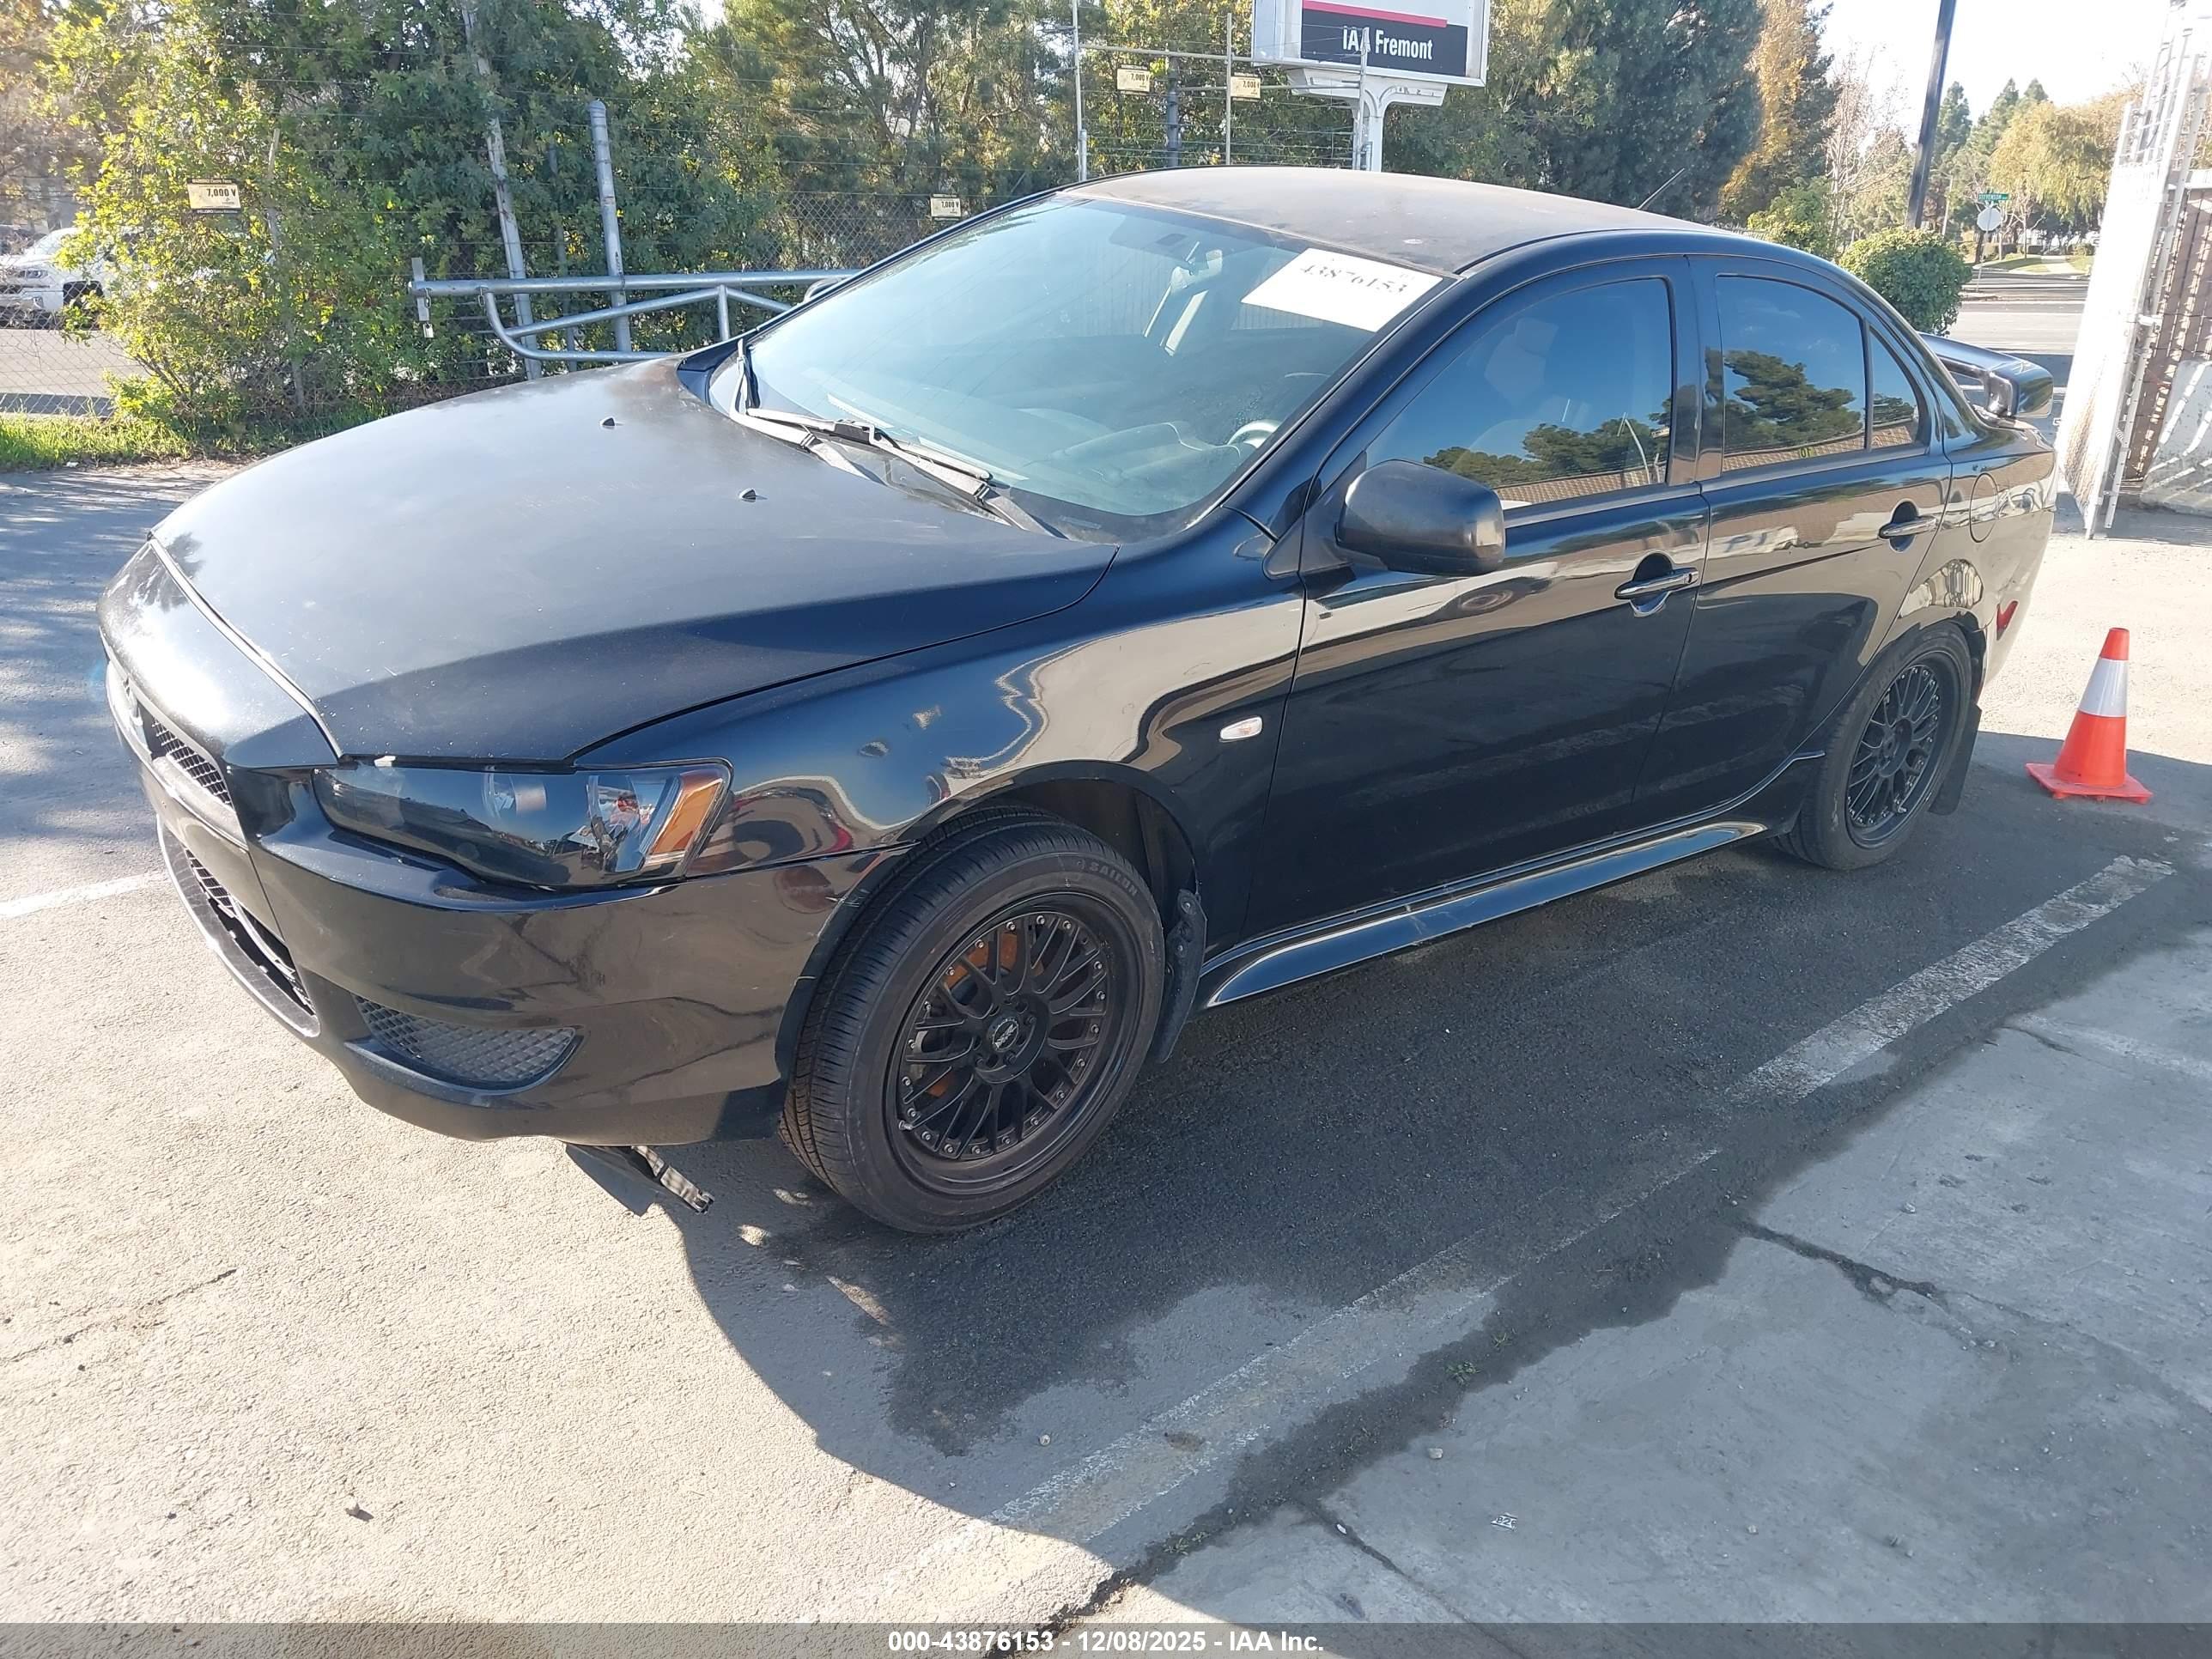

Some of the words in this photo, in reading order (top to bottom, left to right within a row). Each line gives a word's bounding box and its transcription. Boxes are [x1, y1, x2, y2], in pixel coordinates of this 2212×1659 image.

[1375, 29, 1433, 60] Fremont
[206, 188, 229, 198] 7,000
[231, 188, 237, 197] V
